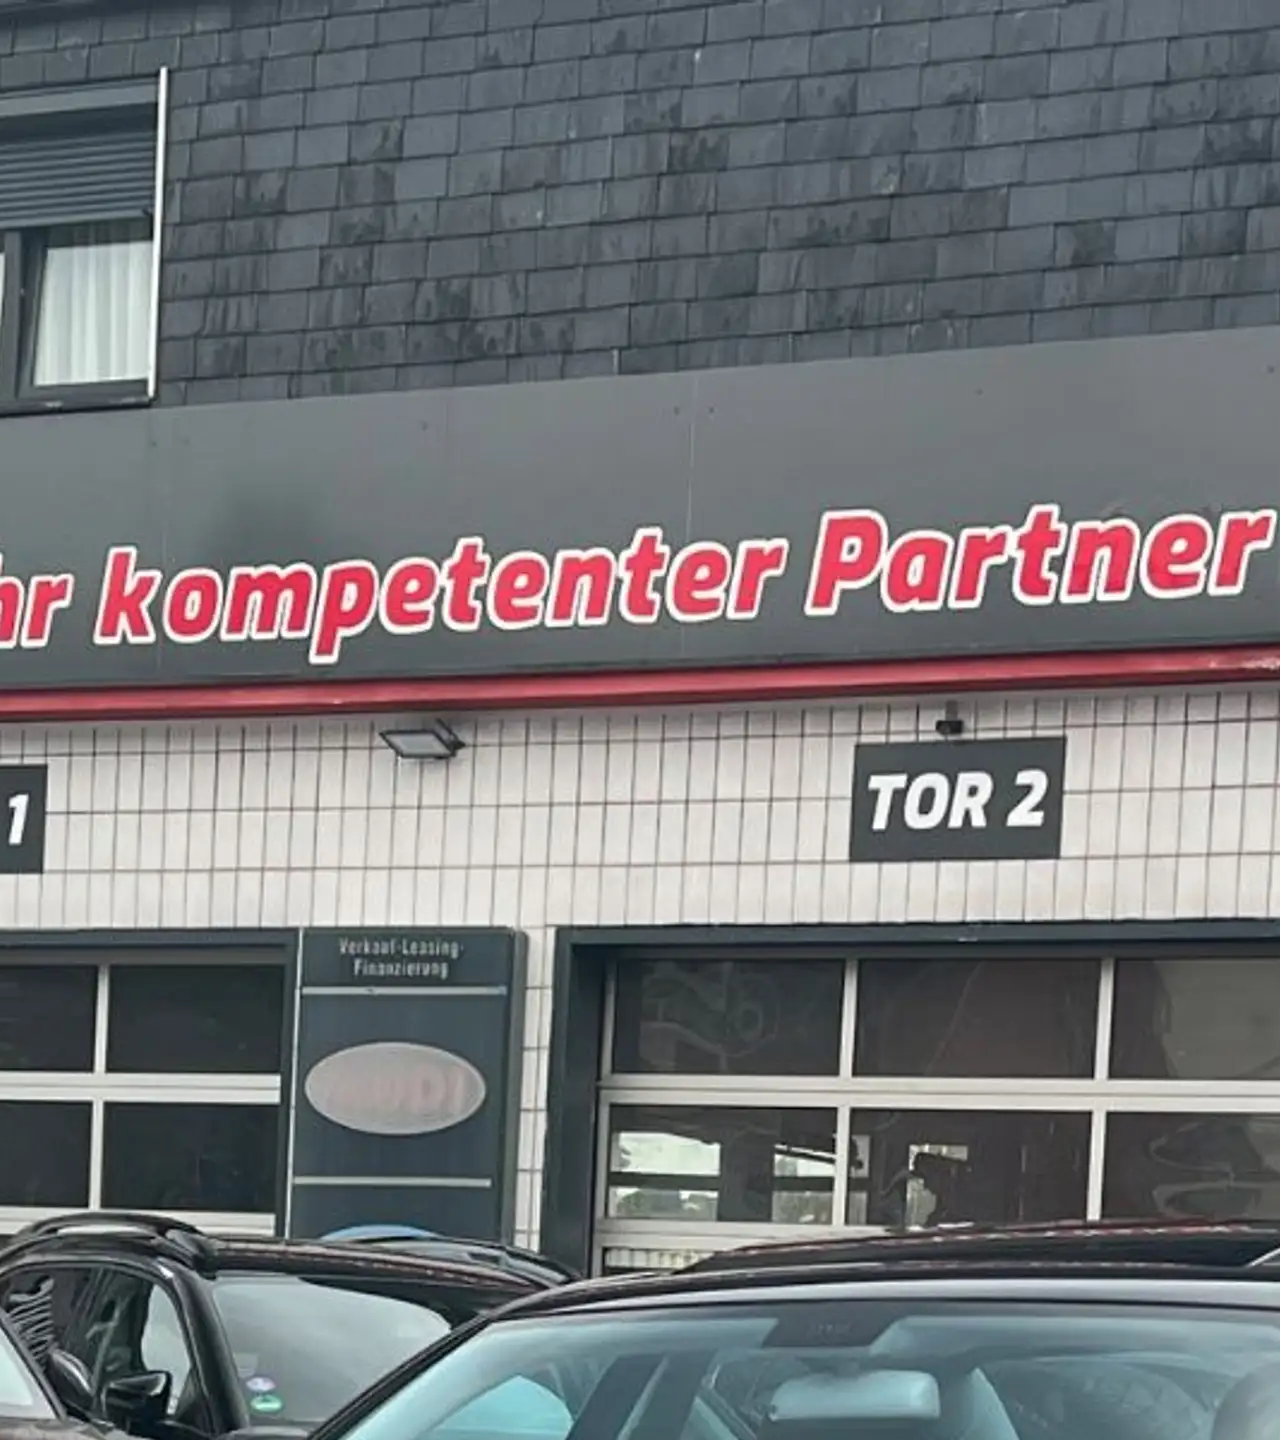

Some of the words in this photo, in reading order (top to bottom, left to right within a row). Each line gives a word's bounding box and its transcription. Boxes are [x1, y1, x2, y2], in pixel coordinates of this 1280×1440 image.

[93, 527, 790, 665] kompetenter
[805, 504, 1277, 616] Partner
[7, 793, 31, 845] 1
[866, 770, 994, 830] TOR
[1006, 768, 1048, 829] 2
[353, 959, 448, 980] Finanzierung
